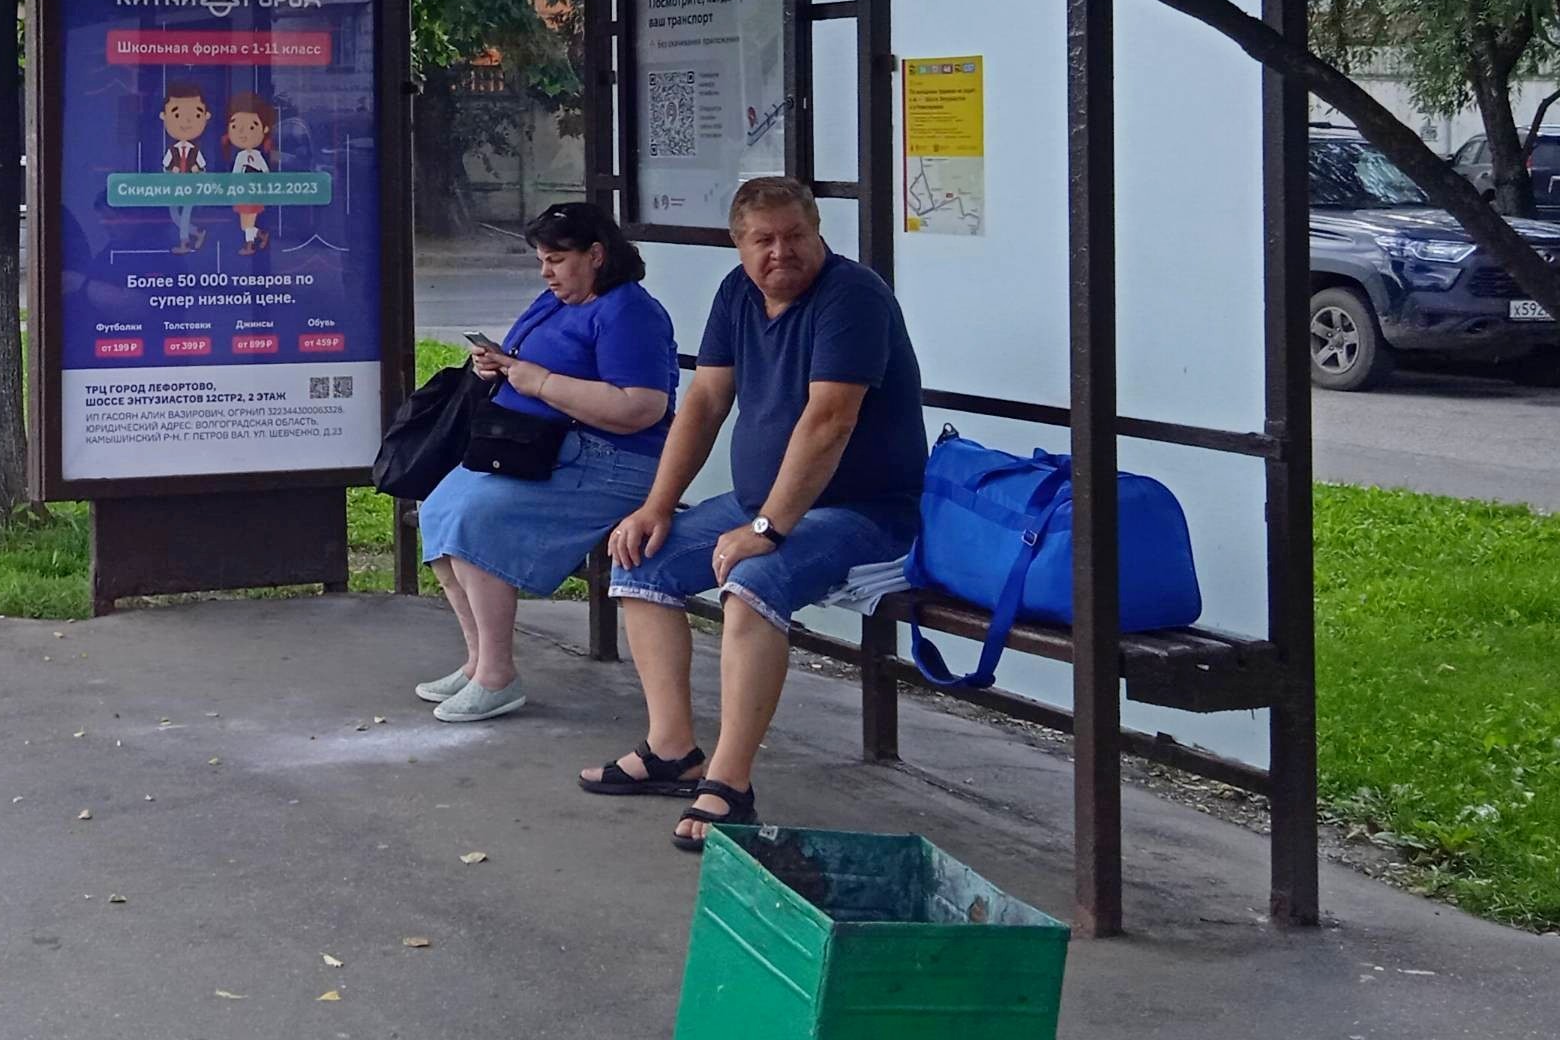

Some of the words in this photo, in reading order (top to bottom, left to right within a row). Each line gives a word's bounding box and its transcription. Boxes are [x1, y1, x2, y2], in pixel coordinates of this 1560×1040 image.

[648, 17, 666, 28] ваш
[667, 13, 713, 29] транспорт
[117, 41, 189, 54] Школьная
[192, 42, 238, 56] форма
[241, 45, 249, 54] с
[252, 43, 279, 55] 1-11
[282, 45, 321, 55] класс
[117, 183, 171, 196] Скидки
[174, 185, 193, 196] до
[196, 183, 224, 195] 70%
[226, 185, 245, 196] до
[248, 182, 319, 195] 31.12.2023
[127, 274, 174, 288] Более
[177, 274, 196, 287] 50
[200, 273, 228, 287] 000
[231, 275, 292, 288] товаров
[295, 275, 314, 285] по
[149, 295, 195, 309] супер
[198, 291, 252, 306] низкой
[256, 293, 296, 306] цене.
[95, 323, 142, 333] Футболки
[163, 321, 211, 330] Толстовки
[235, 320, 274, 330] Джинсы
[307, 318, 335, 328] Обувь
[169, 343, 180, 351] от
[237, 341, 248, 349] от
[85, 385, 108, 395] ТРЦ
[109, 384, 146, 394] ГОРОД
[148, 382, 217, 393] ЛЕФОРТОВО,
[85, 397, 125, 407] ШОССЕ
[127, 394, 204, 406] ЭНТУЗИАСТОВ
[248, 392, 255, 402] 2
[256, 392, 287, 401] ЭТАЖ
[86, 413, 100, 422] ИП
[140, 411, 166, 420] АЛИК
[228, 407, 266, 417] ОГРНИП
[86, 421, 159, 433] ЮРИДИЧЕСКИЙ
[195, 418, 274, 430] ВОЛГОГРАДСКАЯ
[86, 432, 161, 444] КАМЫШИНСКИЙ
[192, 431, 229, 440] ПЕТРОВ
